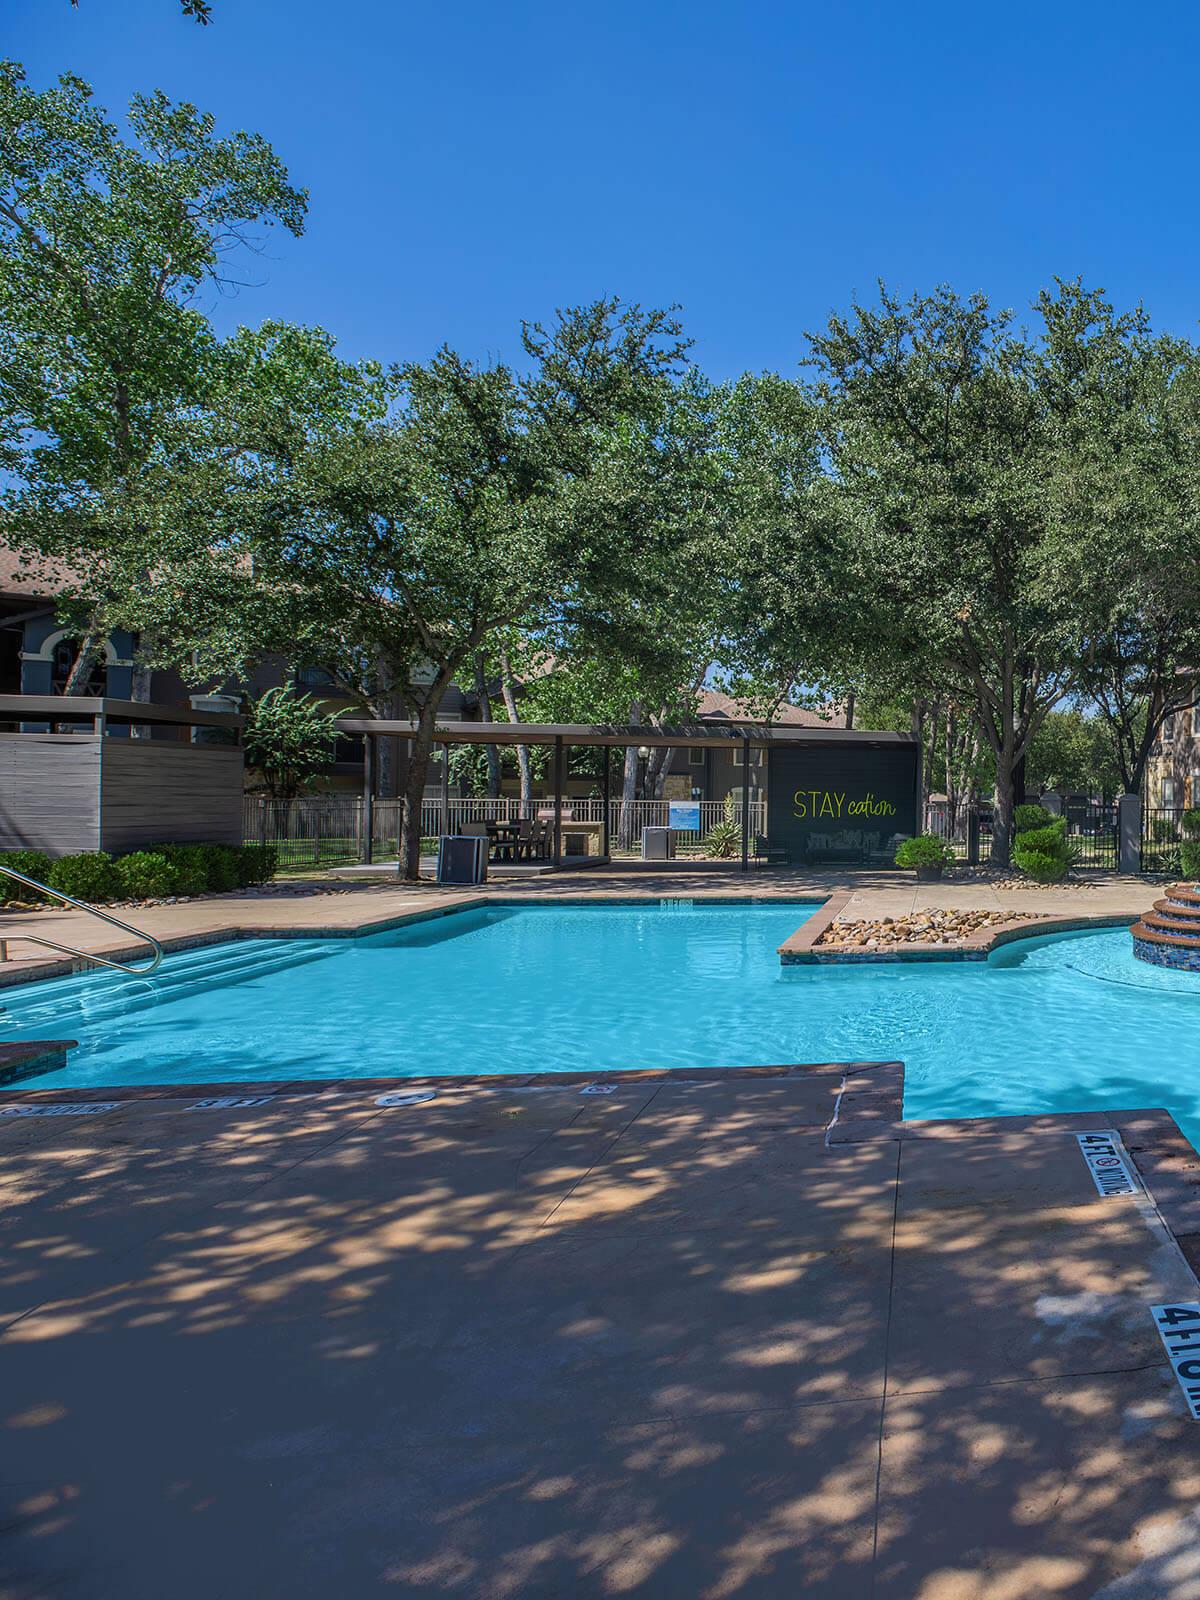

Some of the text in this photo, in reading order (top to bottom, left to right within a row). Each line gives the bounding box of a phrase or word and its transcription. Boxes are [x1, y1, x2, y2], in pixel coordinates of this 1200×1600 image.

[793, 791, 897, 818] STAY cation
[1080, 1135, 1110, 1144] 4
